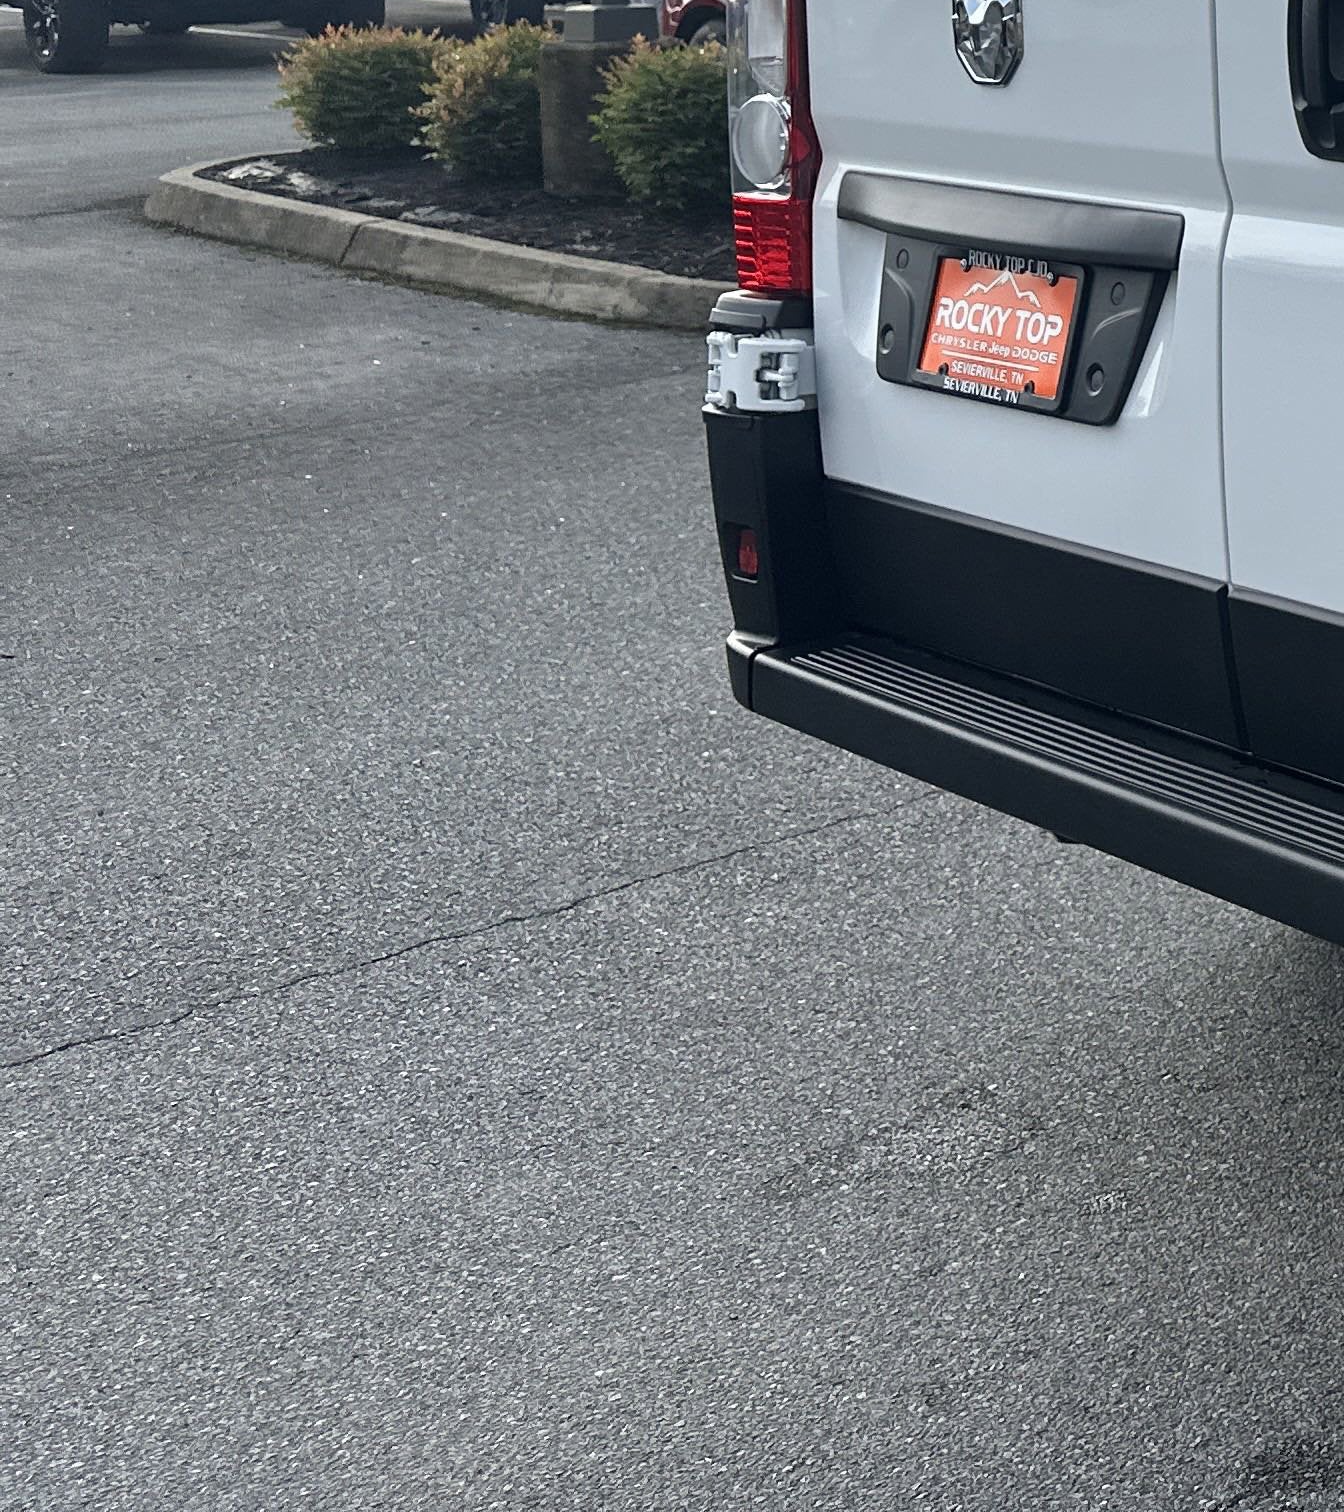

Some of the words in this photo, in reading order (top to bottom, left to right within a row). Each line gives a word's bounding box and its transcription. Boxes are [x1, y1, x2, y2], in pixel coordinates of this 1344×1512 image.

[968, 249, 1002, 270] ROCKY
[1005, 255, 1025, 274] TOP
[935, 297, 1014, 337] ROCKY
[1015, 308, 1063, 345] TOP
[931, 332, 988, 352] CHRYSLER
[988, 341, 1010, 358] Jeep
[1011, 346, 1058, 364] DODGE
[951, 360, 1008, 383] SEVIERVILLE,
[1011, 371, 1024, 385] TN
[943, 376, 1002, 402] SEVIERVILLE,
[1005, 389, 1019, 404] TN
